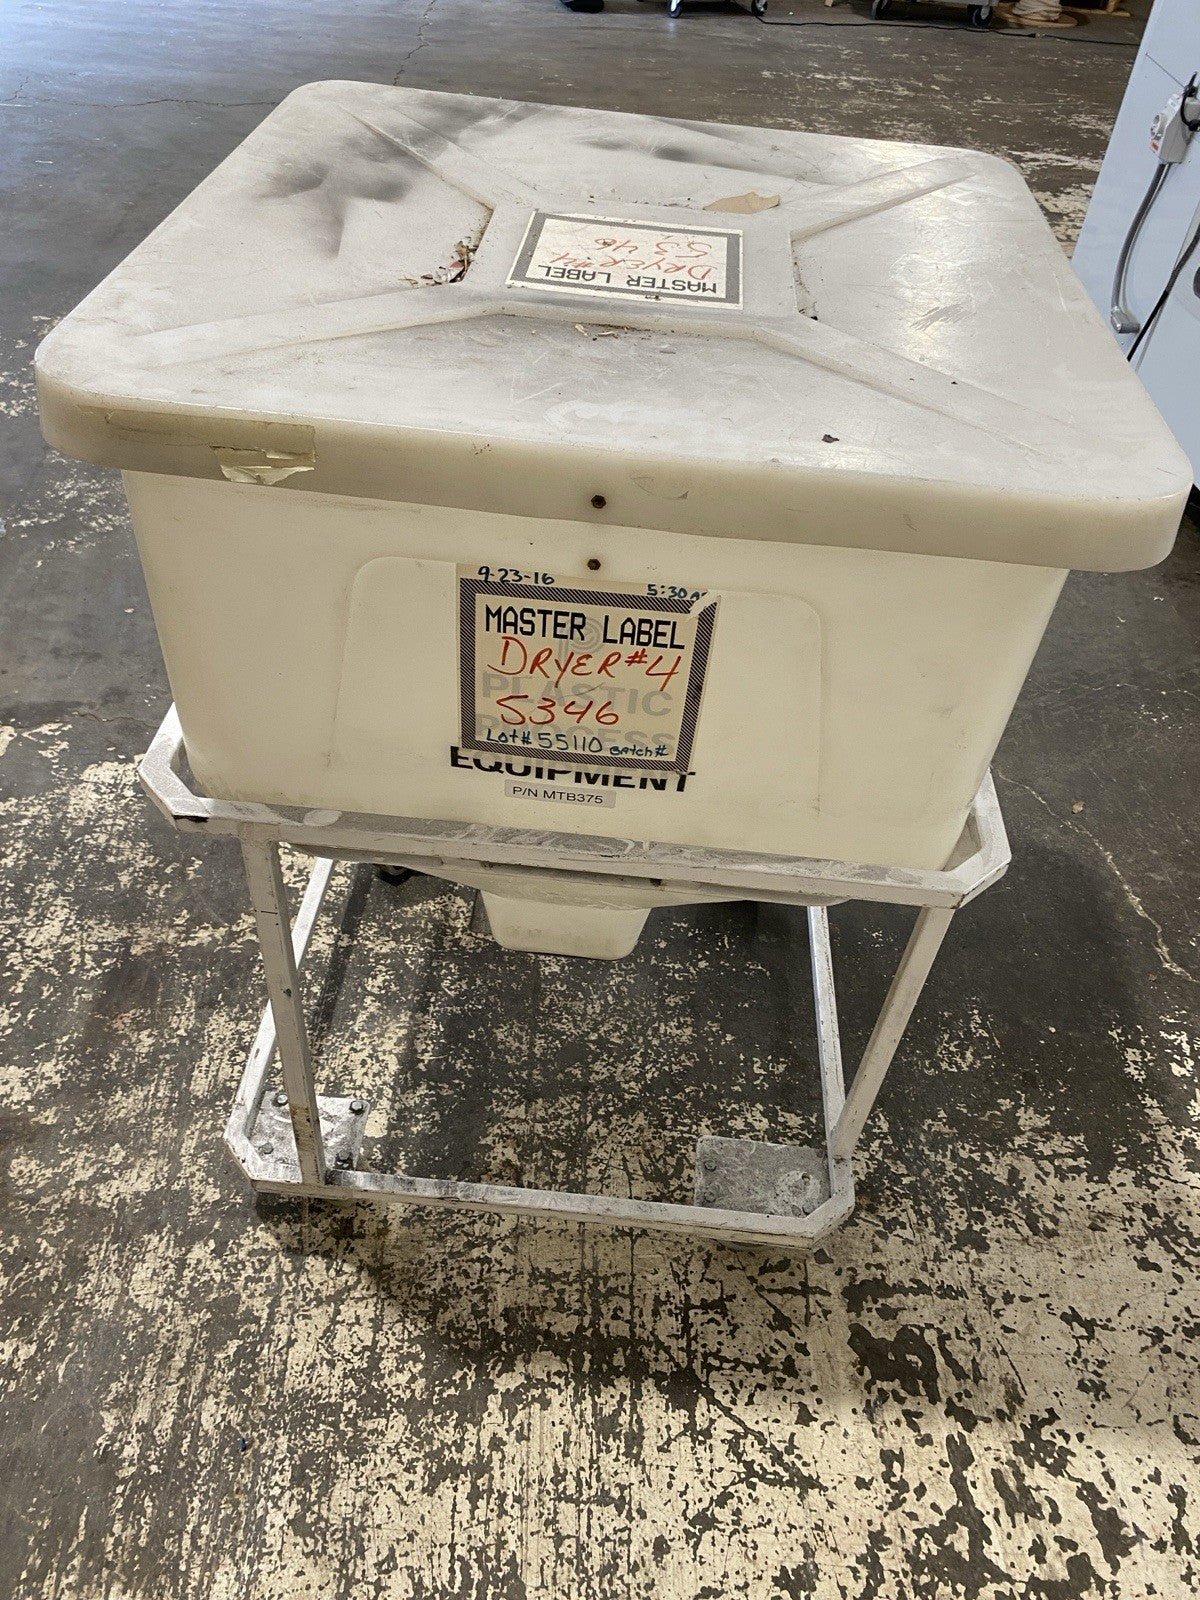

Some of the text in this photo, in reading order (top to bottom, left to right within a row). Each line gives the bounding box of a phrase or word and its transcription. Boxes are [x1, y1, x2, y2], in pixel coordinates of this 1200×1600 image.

[538, 264, 717, 293] MASTER LABEL
[478, 566, 555, 585] 9-23-16
[485, 604, 685, 650] MASTER LABEL
[538, 732, 603, 753] 55110
[512, 786, 603, 804] P/N MTB375
